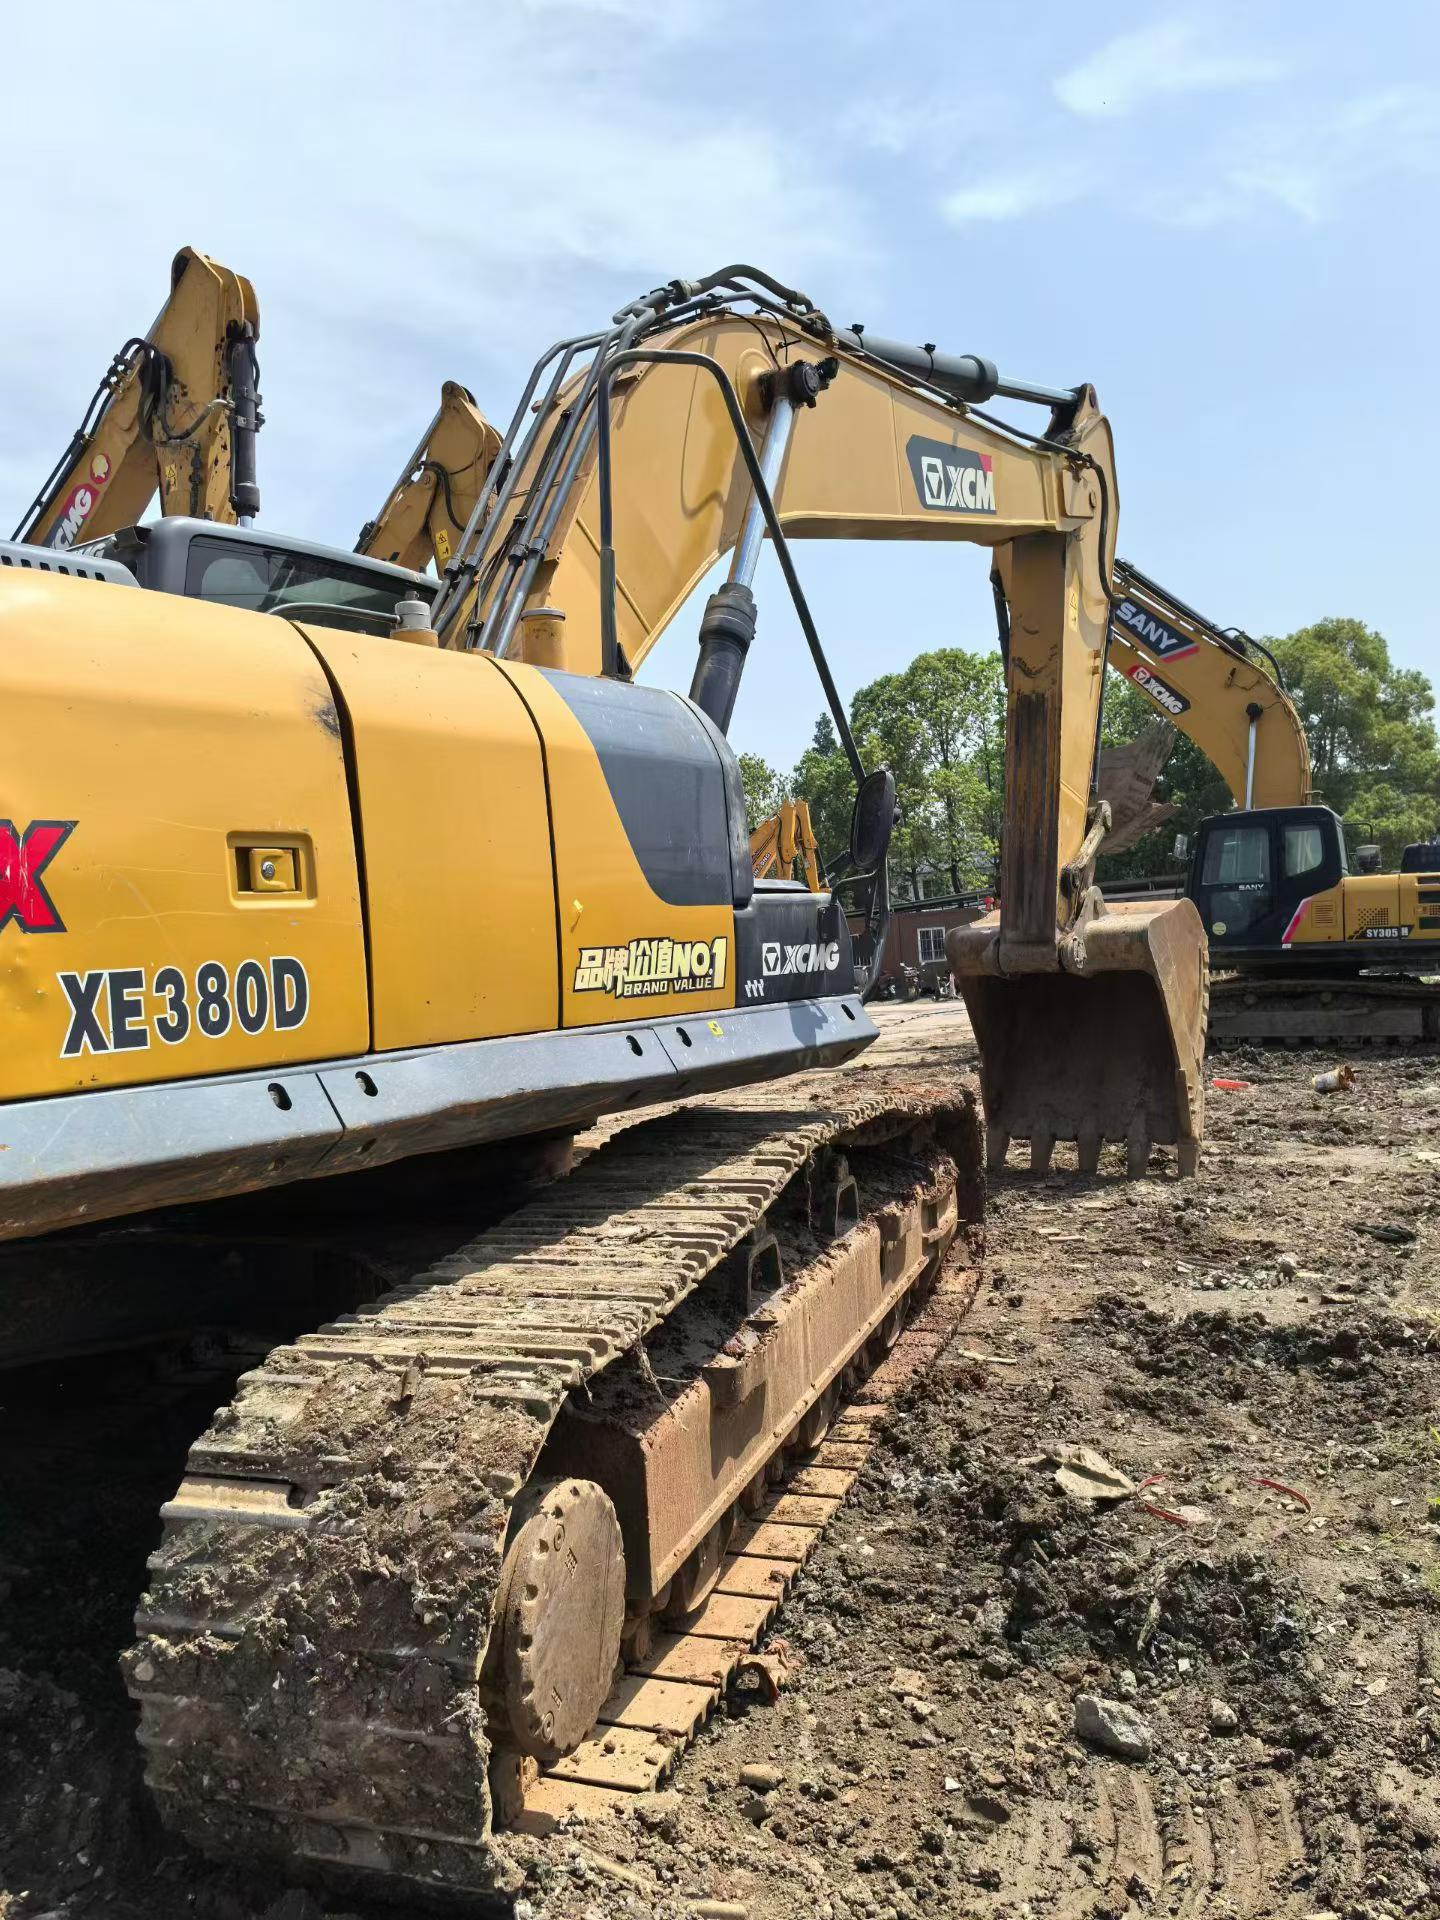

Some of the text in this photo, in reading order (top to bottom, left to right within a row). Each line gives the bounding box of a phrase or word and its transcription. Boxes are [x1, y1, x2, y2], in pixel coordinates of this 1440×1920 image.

[1115, 602, 1178, 650] SANY
[1144, 677, 1184, 715] XCMG
[1238, 883, 1264, 891] SANY
[782, 942, 840, 975] XCMG
[624, 976, 712, 995] BRAND VALUE
[56, 955, 309, 1058] XE380D
